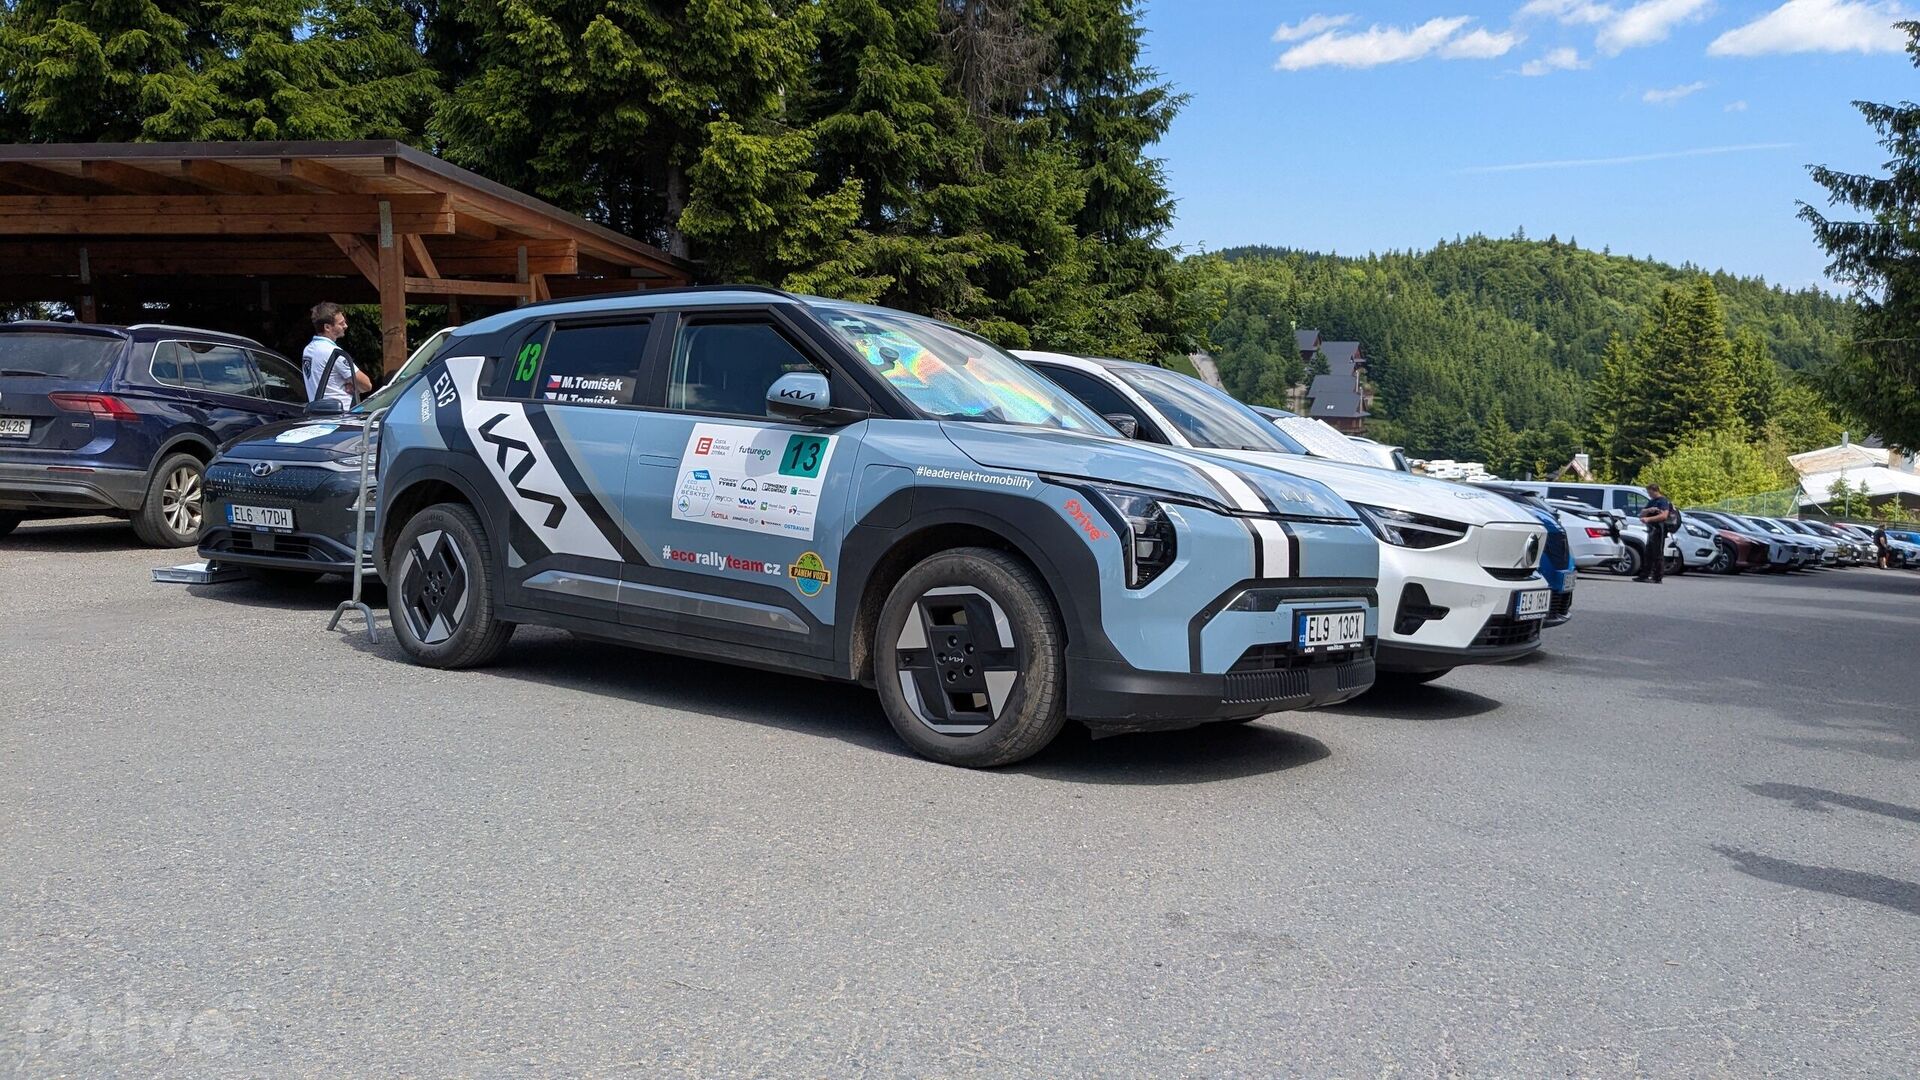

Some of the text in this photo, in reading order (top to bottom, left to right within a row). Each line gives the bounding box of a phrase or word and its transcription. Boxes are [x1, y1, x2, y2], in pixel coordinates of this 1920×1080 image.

[515, 343, 541, 381] 13
[433, 371, 456, 407] EV3
[561, 376, 623, 391] M.Tomíšek
[780, 389, 816, 400] KIA
[0, 420, 26, 433] 9426
[739, 445, 772, 461] futurego
[792, 441, 820, 471] 13
[718, 480, 737, 488] TYRES
[916, 466, 1034, 491] #leaderelektromobility
[681, 490, 711, 498] BESKYDY
[684, 484, 707, 492] RALLYE
[234, 507, 288, 526] EL6 17DH
[662, 545, 781, 576] #ecorallyteamcz
[1308, 614, 1360, 642] EL9 13CX
